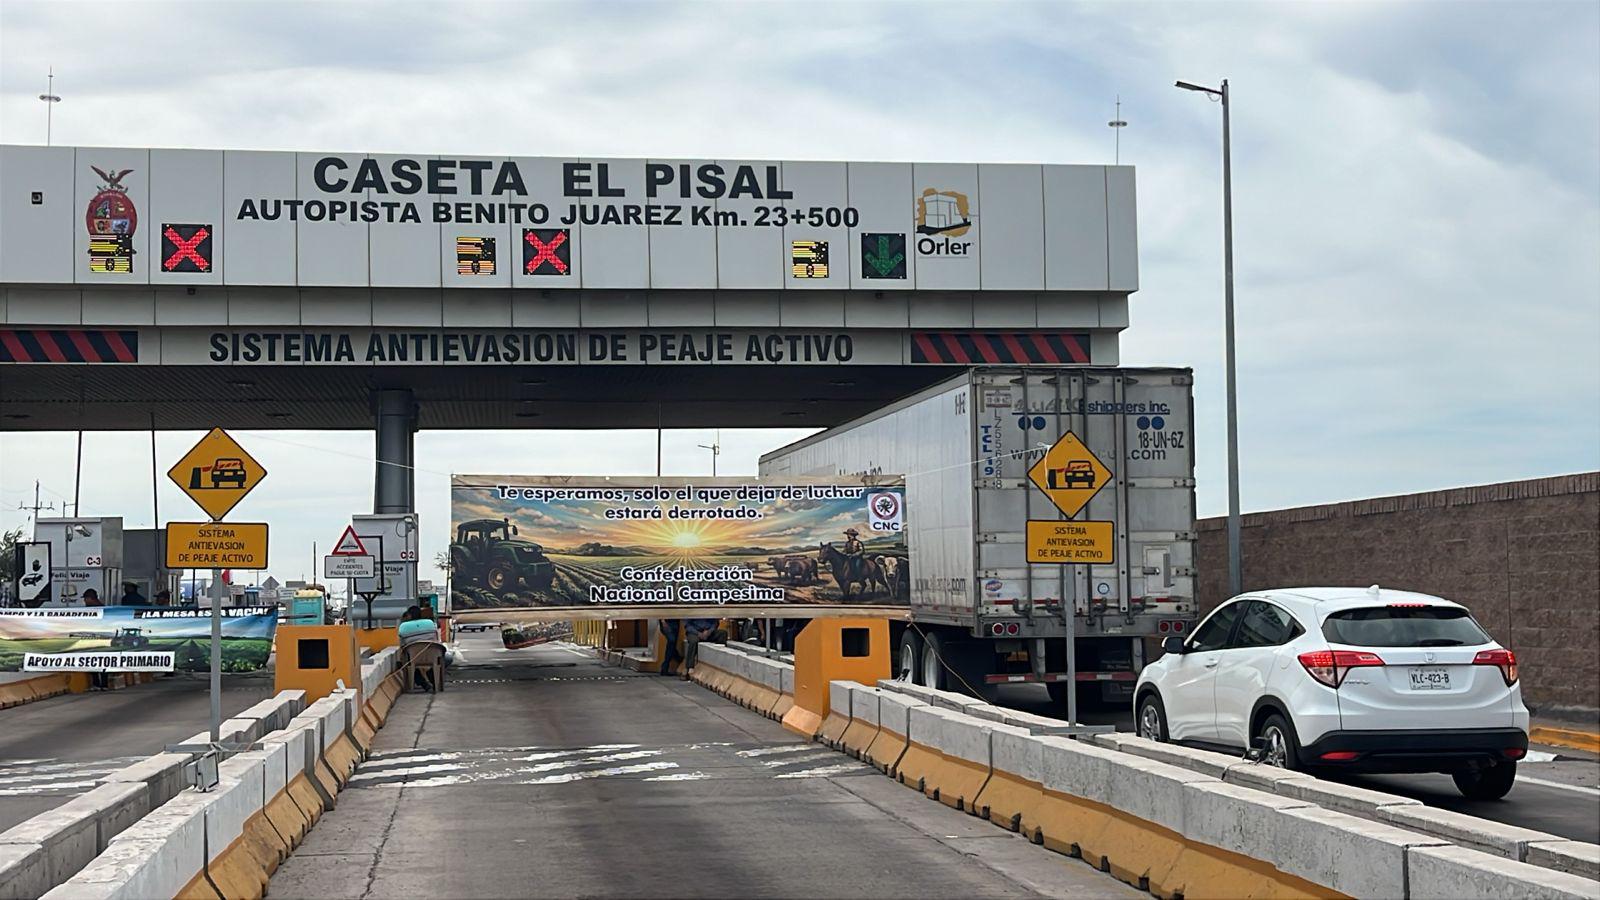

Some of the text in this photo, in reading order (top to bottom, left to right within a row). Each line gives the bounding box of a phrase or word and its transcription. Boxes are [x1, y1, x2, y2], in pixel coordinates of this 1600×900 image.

[313, 157, 793, 200] CASETA EL PISAL
[237, 199, 859, 228] AUTOPISTA BENITO JUAREZ Km. 23+500
[917, 237, 971, 255] Orler
[209, 333, 853, 363] SISTEMA ANTIEVASION DE PEAJE ACTIVO
[1149, 401, 1170, 413] inc.
[1138, 431, 1184, 449] 18-UN-6Z
[498, 485, 863, 503] Te esperamos, solo el que deja de luchar
[605, 505, 763, 519] estará derrotado.
[872, 522, 899, 531] CNC
[1054, 526, 1087, 535] SISTEMA
[198, 529, 235, 538] SISTEMA
[188, 541, 245, 550] ANTIEVASION
[1046, 538, 1095, 547] ANTIEVASION
[178, 553, 254, 563] DE PEAJE ACTIVO
[1037, 549, 1103, 559] DE PEAJE ACTIVO
[87, 557, 101, 565] C-3
[70, 572, 90, 580] Viaje
[620, 566, 753, 581] Confederación
[590, 586, 784, 604] Nacional Campesima
[162, 610, 196, 618] MESA
[28, 655, 171, 668] APOYO AL SECTOR PRIMARIO
[1411, 673, 1449, 684] VLC-423-B
